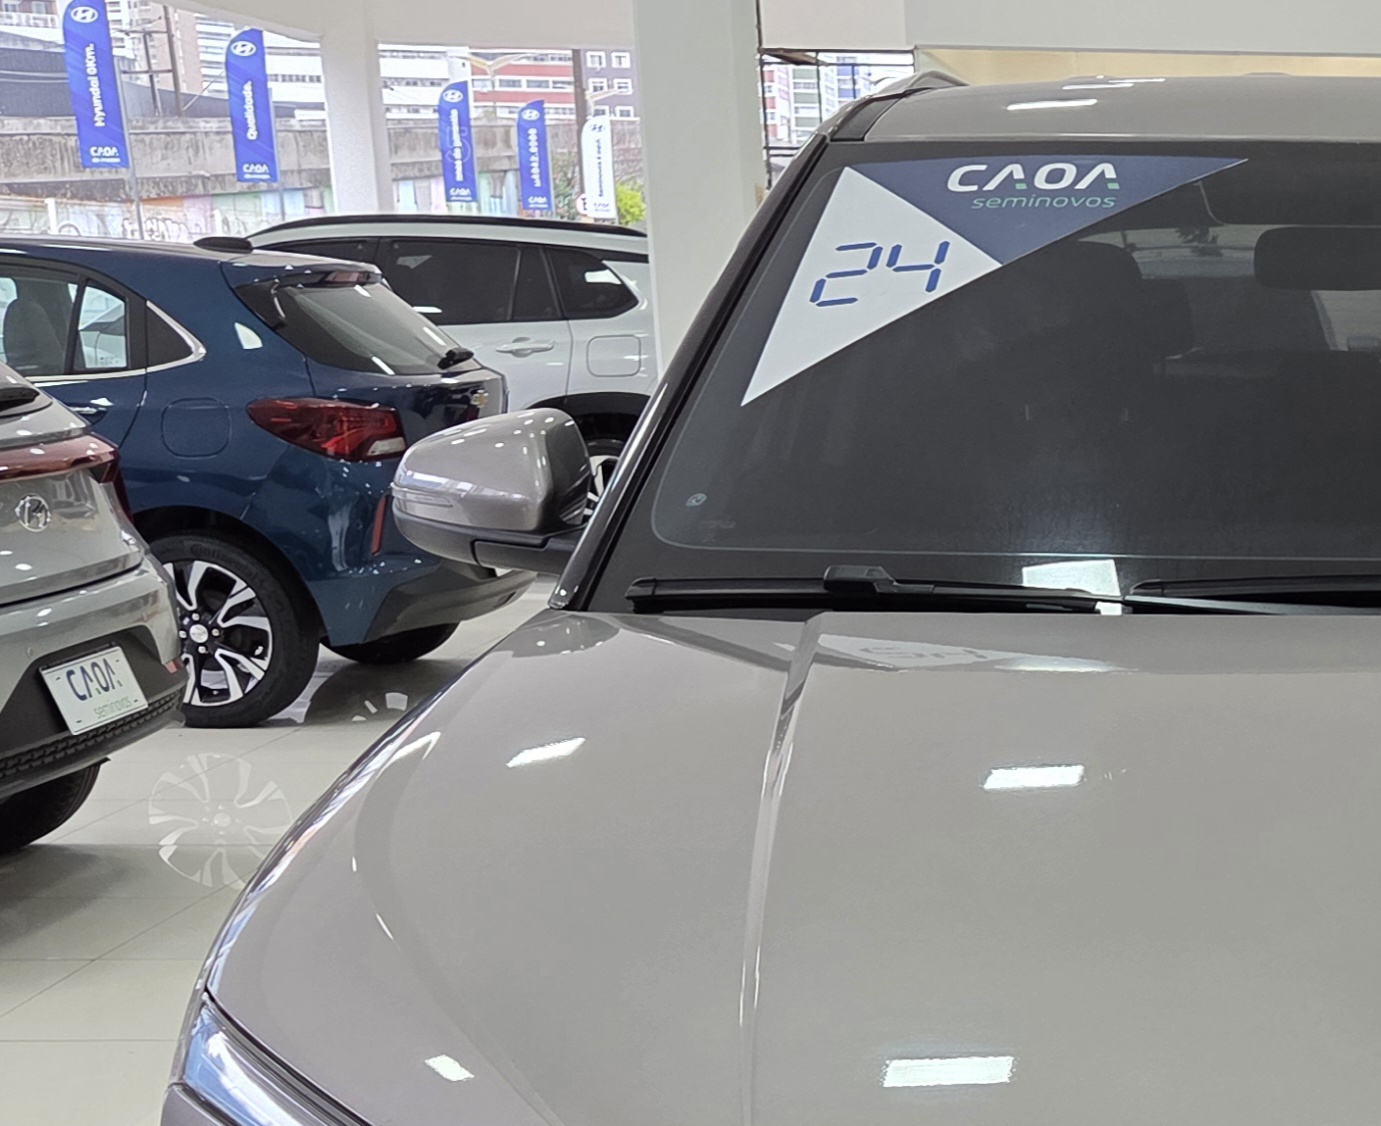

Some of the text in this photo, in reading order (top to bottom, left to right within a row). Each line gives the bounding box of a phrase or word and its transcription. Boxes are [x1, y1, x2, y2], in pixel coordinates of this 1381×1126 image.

[88, 76, 106, 127] Hyundai
[242, 80, 258, 141] Qualidade.
[90, 146, 120, 156] CAOA
[242, 163, 270, 173] CAOA
[947, 162, 1120, 192] CAOA
[971, 194, 1117, 209] seminovos
[809, 241, 950, 307] 24
[66, 657, 123, 701] CAOA
[93, 695, 134, 719] seminovos
